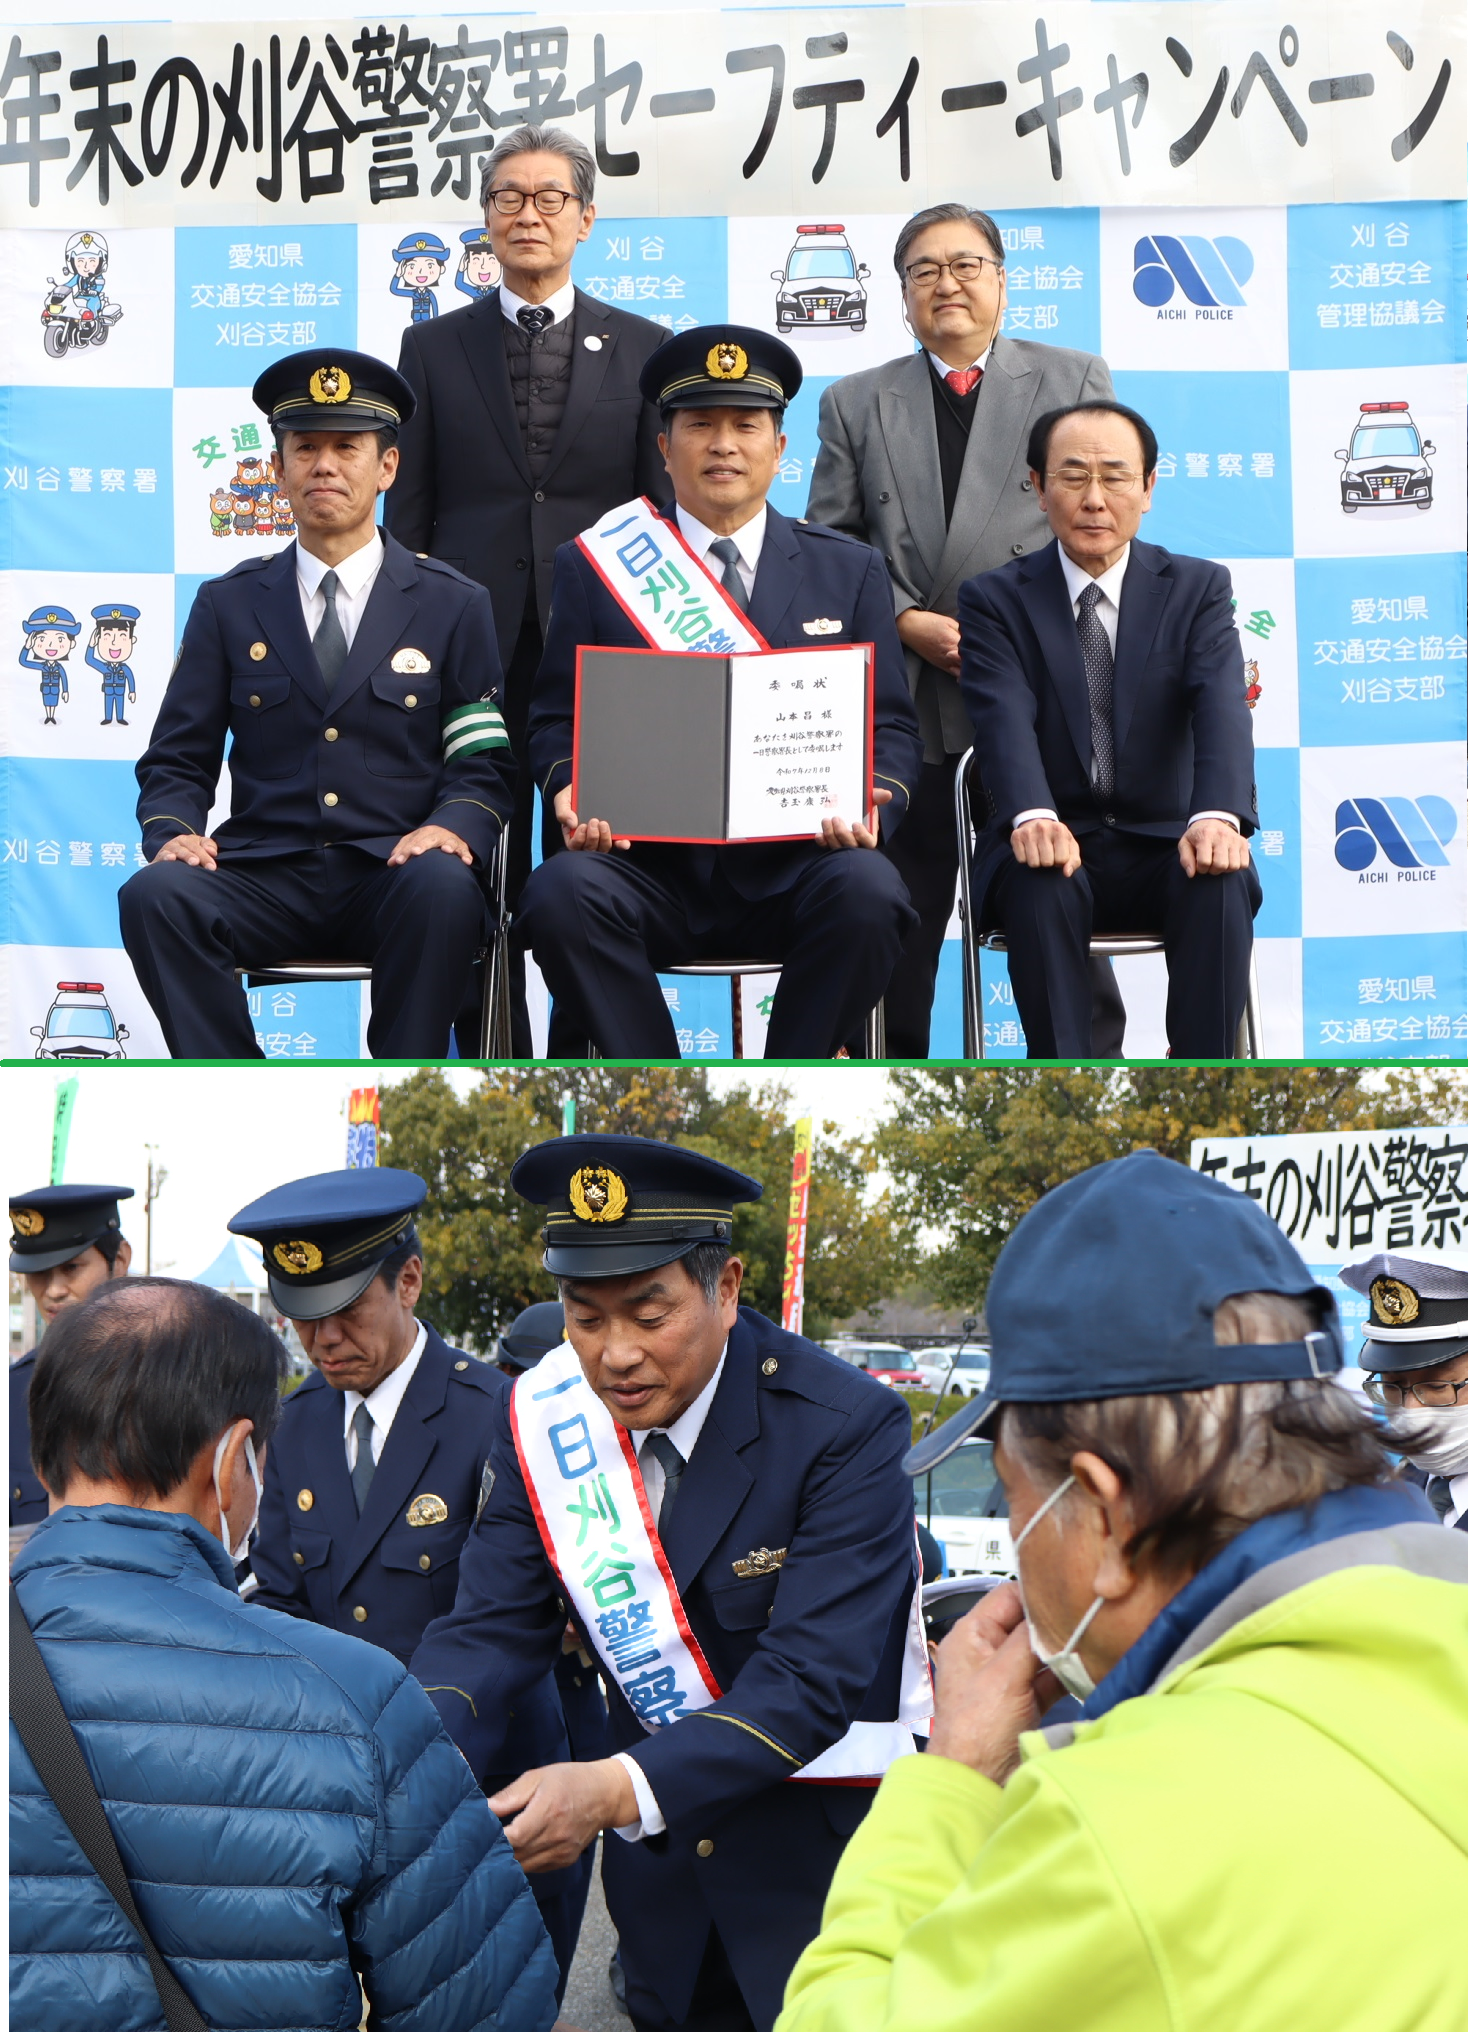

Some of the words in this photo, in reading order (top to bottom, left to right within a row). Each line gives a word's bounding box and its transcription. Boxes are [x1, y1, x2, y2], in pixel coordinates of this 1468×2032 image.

[605, 235, 665, 261] 刈谷
[1351, 222, 1410, 248] 刈谷
[228, 243, 304, 269] 愛知県
[584, 274, 686, 301] 交通安全
[1329, 260, 1432, 289] 交通安全
[190, 281, 342, 309] 交通安全協会
[1157, 309, 1187, 320] AICHI
[1195, 309, 1233, 320] POLICE
[1317, 298, 1446, 328] 管理協議会
[215, 320, 317, 347] 刈谷支部
[192, 423, 276, 469] 交通
[3, 466, 157, 493] 刈谷警察署
[1351, 595, 1429, 625] 愛知県
[1313, 633, 1467, 666] 交通安全協会
[1341, 675, 1446, 704] 刈谷支部
[1358, 872, 1388, 884] AICHI
[1397, 870, 1437, 882] POLICE
[1358, 975, 1437, 1005] 愛知県
